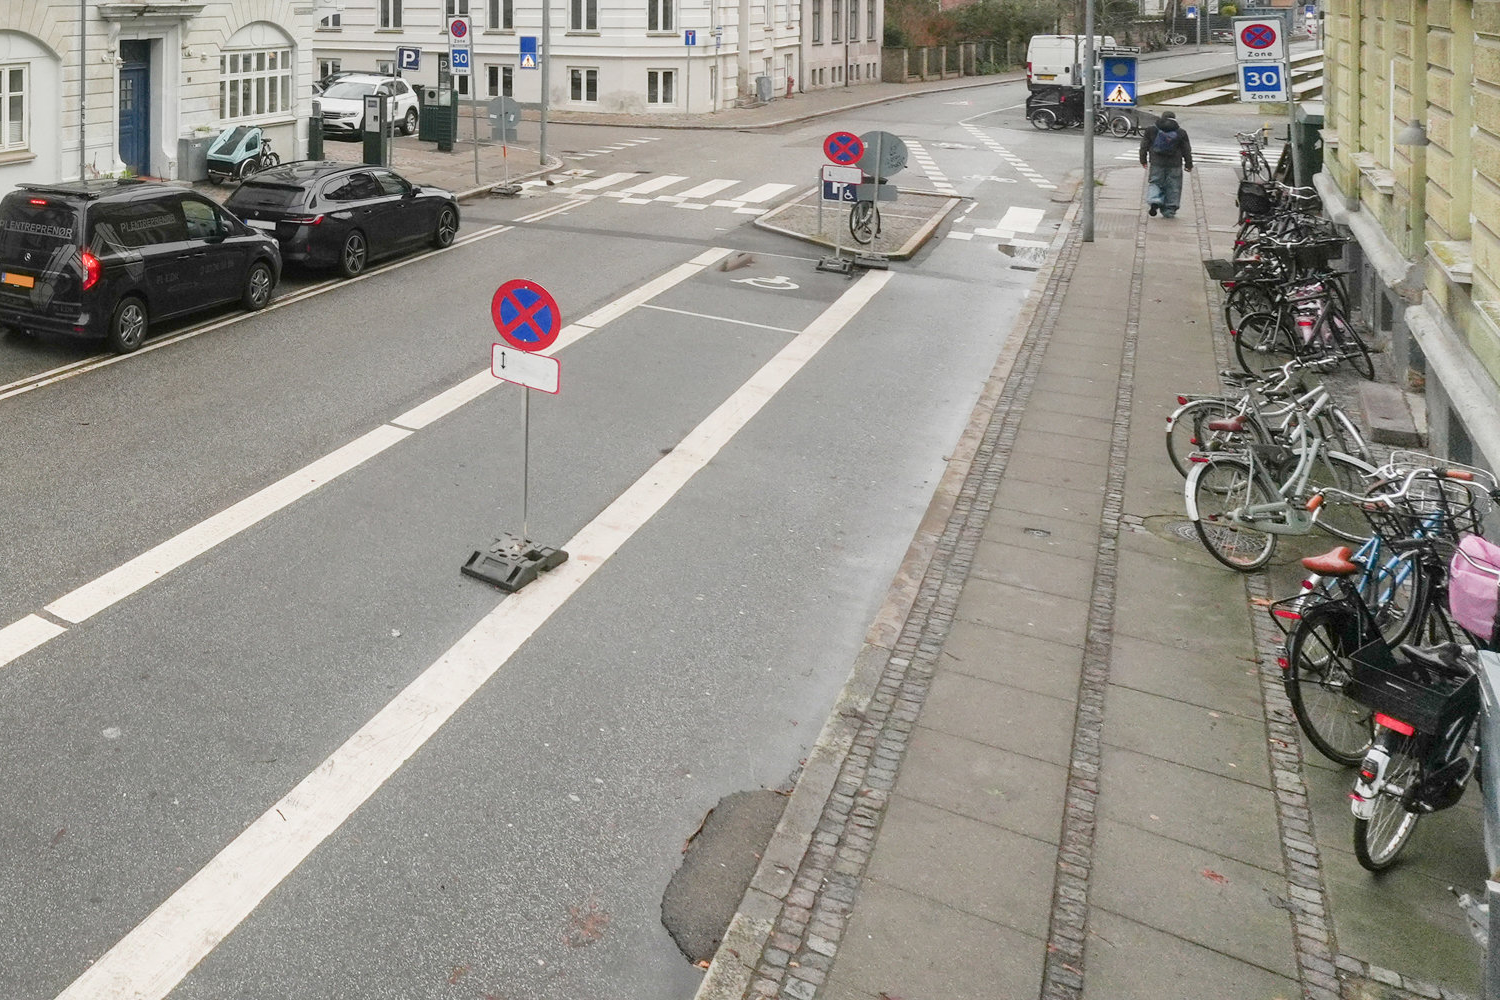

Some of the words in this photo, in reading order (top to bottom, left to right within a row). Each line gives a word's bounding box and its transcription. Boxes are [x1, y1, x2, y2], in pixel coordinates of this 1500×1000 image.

[403, 50, 416, 67] P
[454, 53, 467, 64] 30
[1247, 71, 1278, 87] 30
[10, 220, 73, 238] ENTREPRENØR
